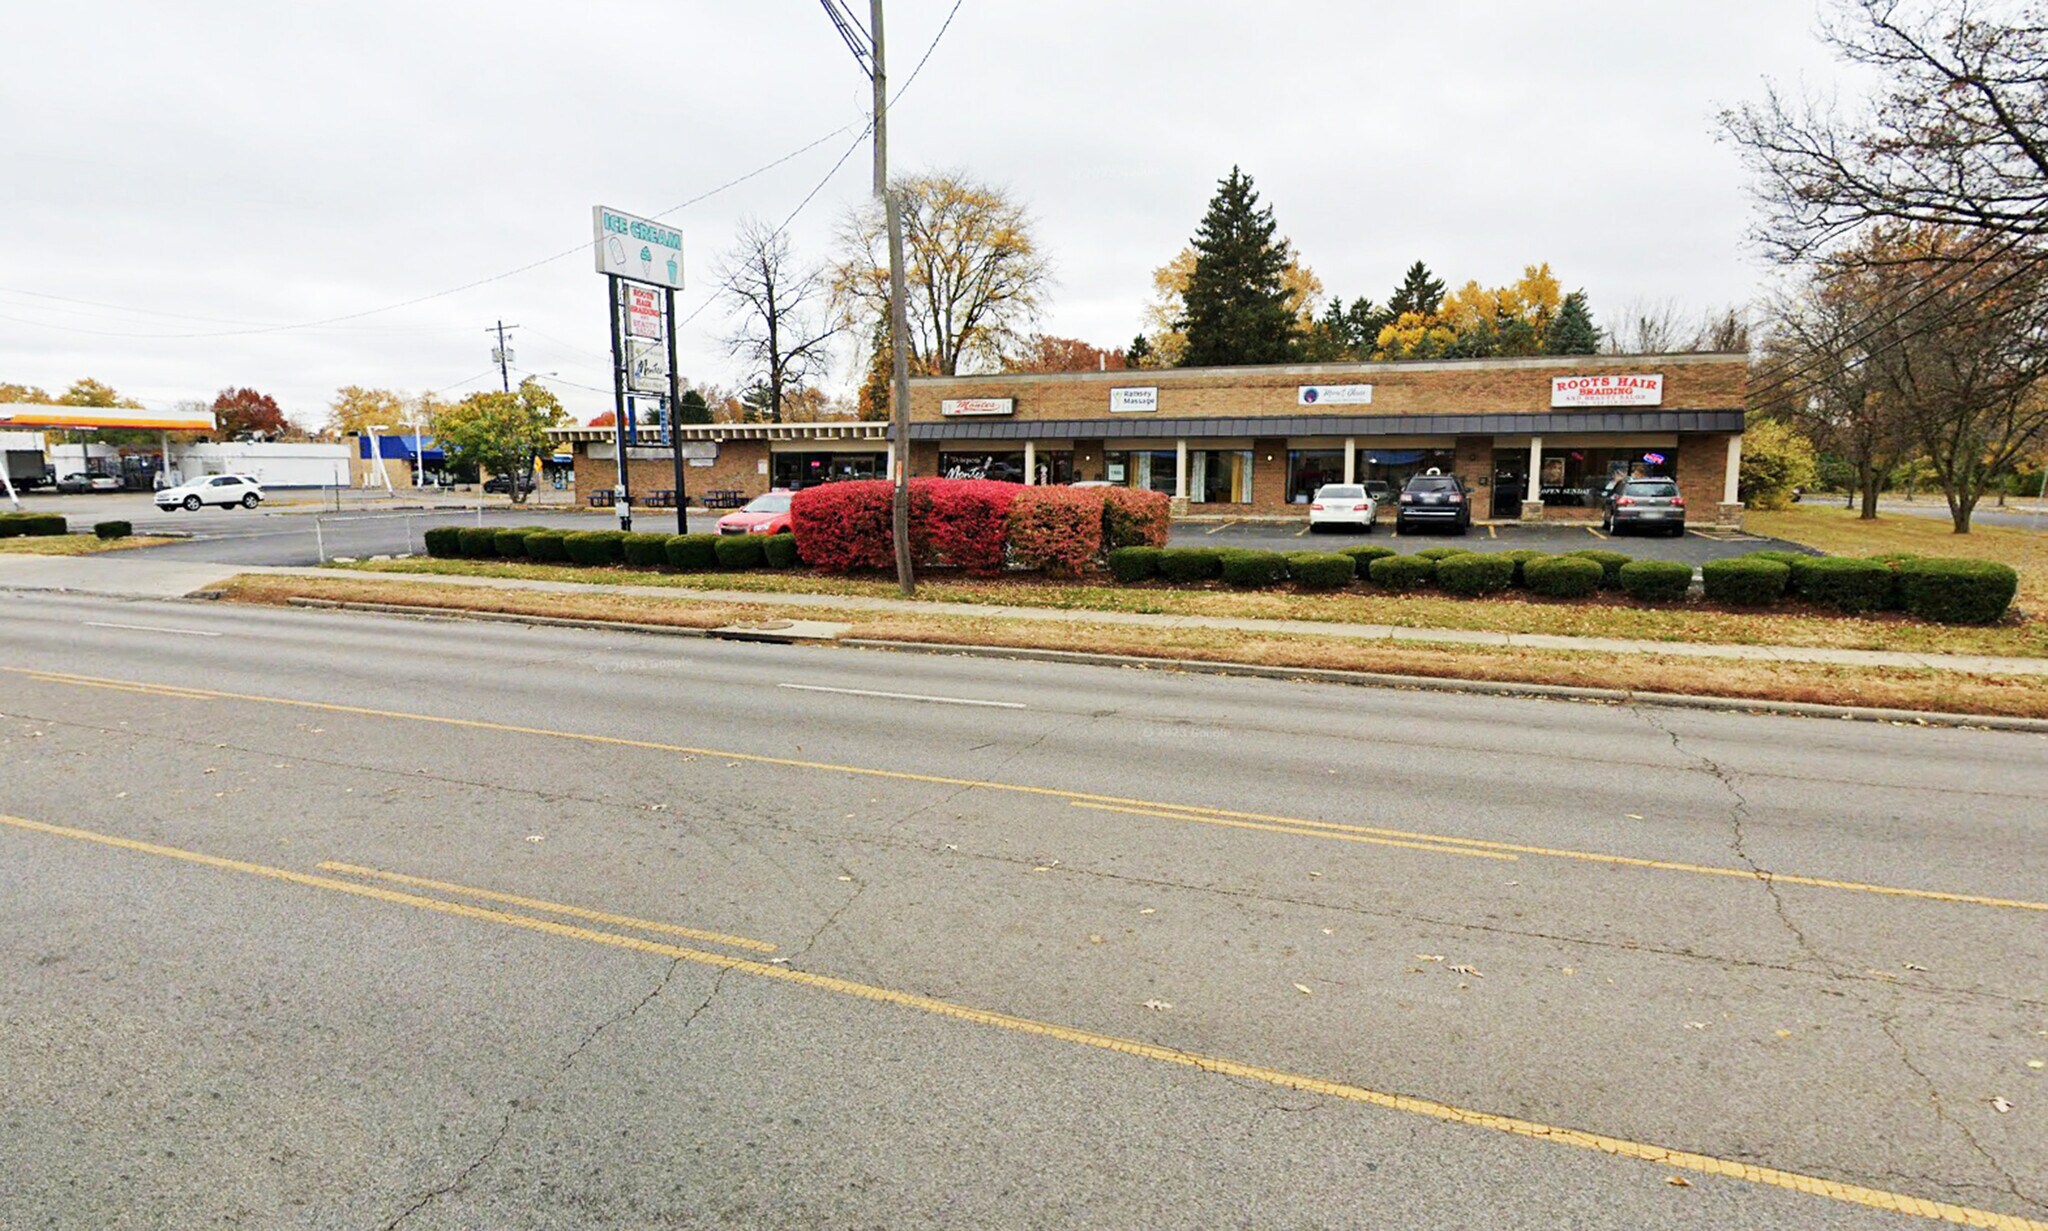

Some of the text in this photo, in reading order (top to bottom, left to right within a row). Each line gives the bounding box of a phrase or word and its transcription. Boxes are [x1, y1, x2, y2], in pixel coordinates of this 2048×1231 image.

[603, 212, 682, 251] ICE CREAM
[633, 288, 654, 300] ROOTS
[636, 298, 652, 308] HAIR
[1556, 377, 1657, 391] ROOTS HAIR
[1579, 387, 1633, 396] BRAIDING
[945, 465, 986, 480] Montes
